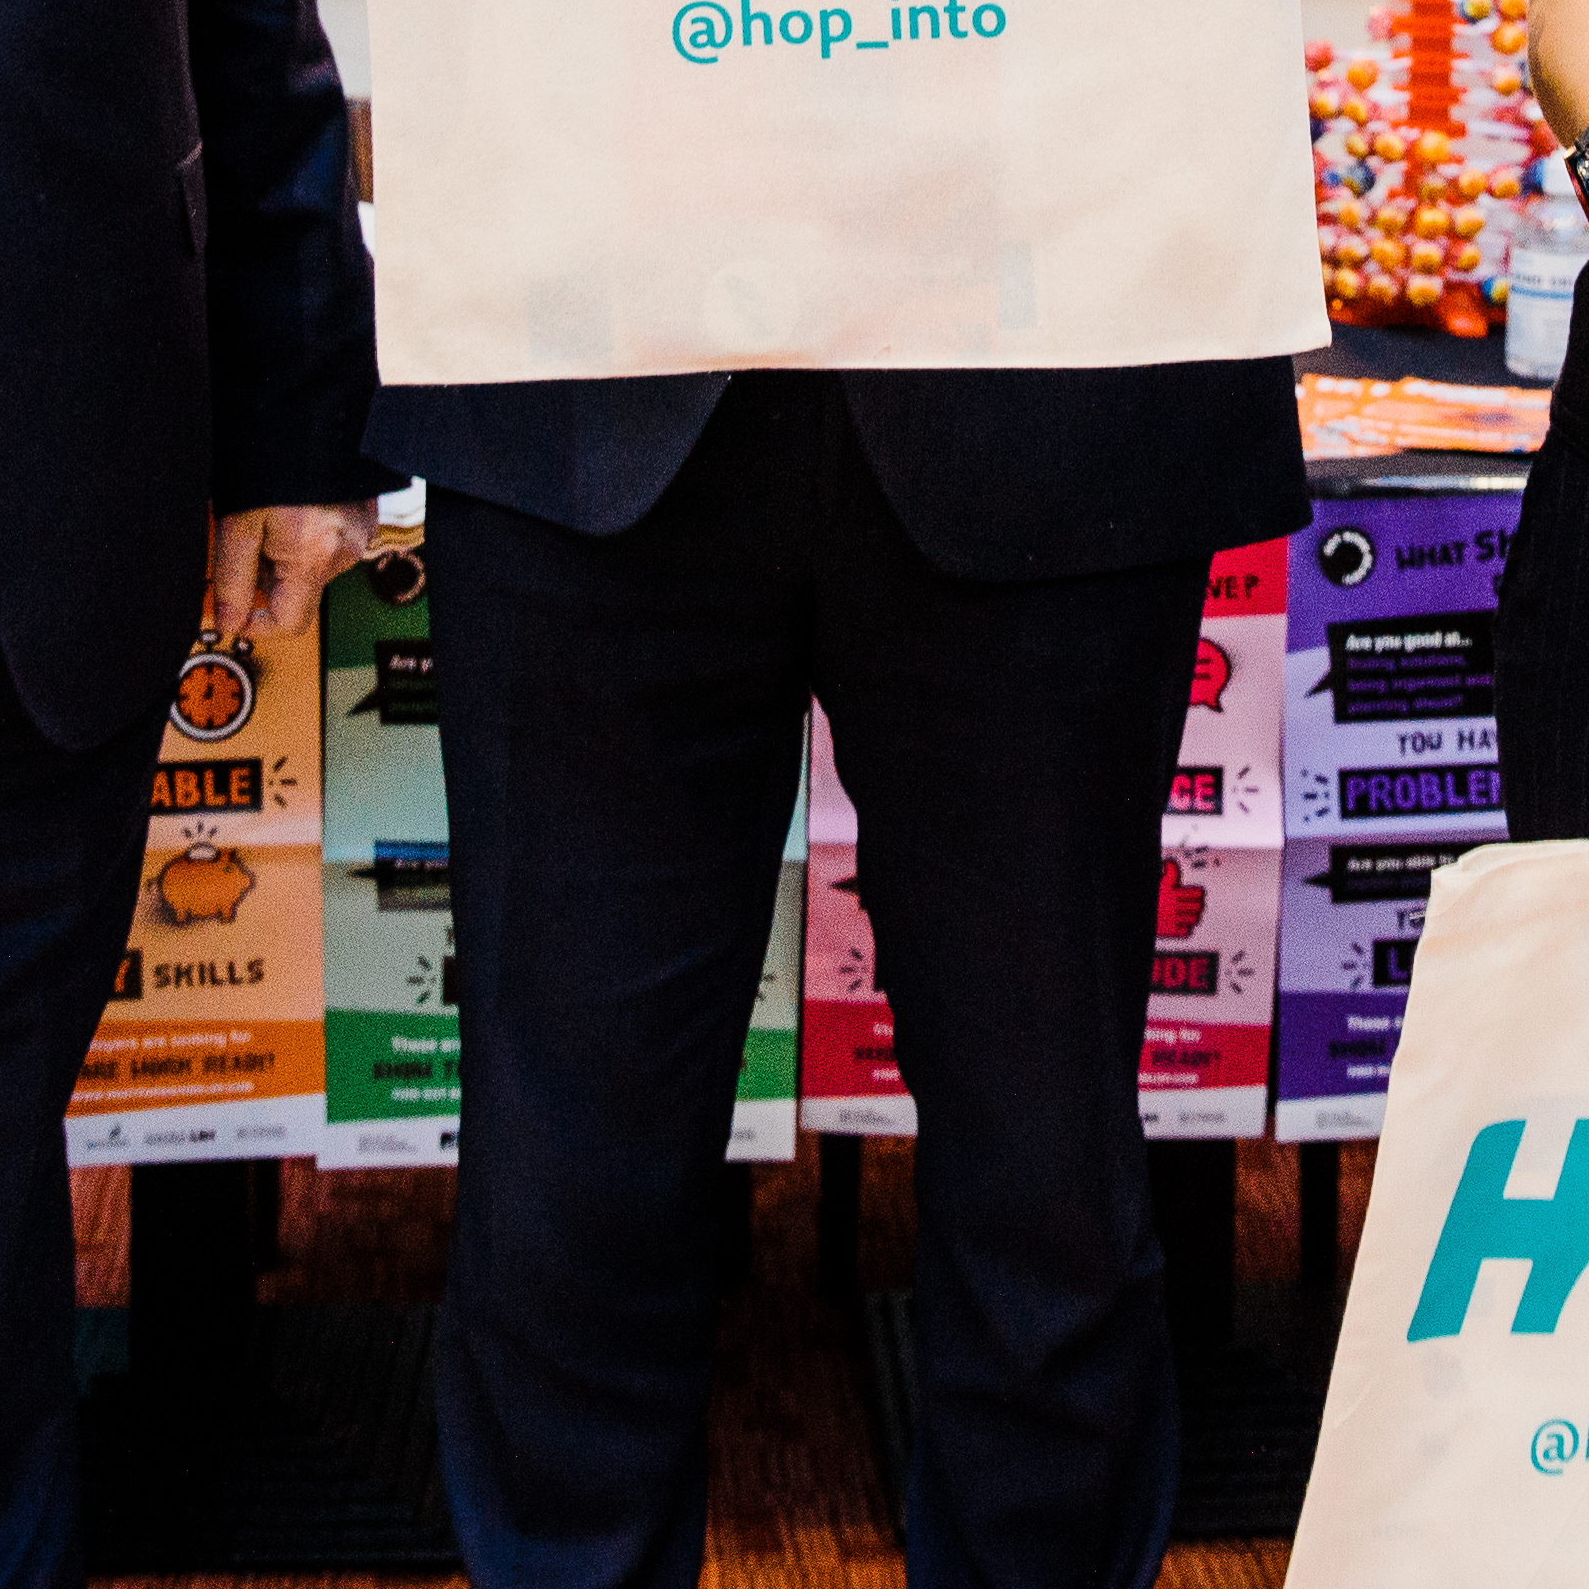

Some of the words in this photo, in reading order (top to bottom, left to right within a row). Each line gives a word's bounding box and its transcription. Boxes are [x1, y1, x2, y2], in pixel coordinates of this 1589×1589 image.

[1395, 541, 1465, 569] WHAT
[1458, 728, 1495, 751] HA
[150, 767, 251, 808] ABLE
[153, 957, 264, 989] SKILLS
